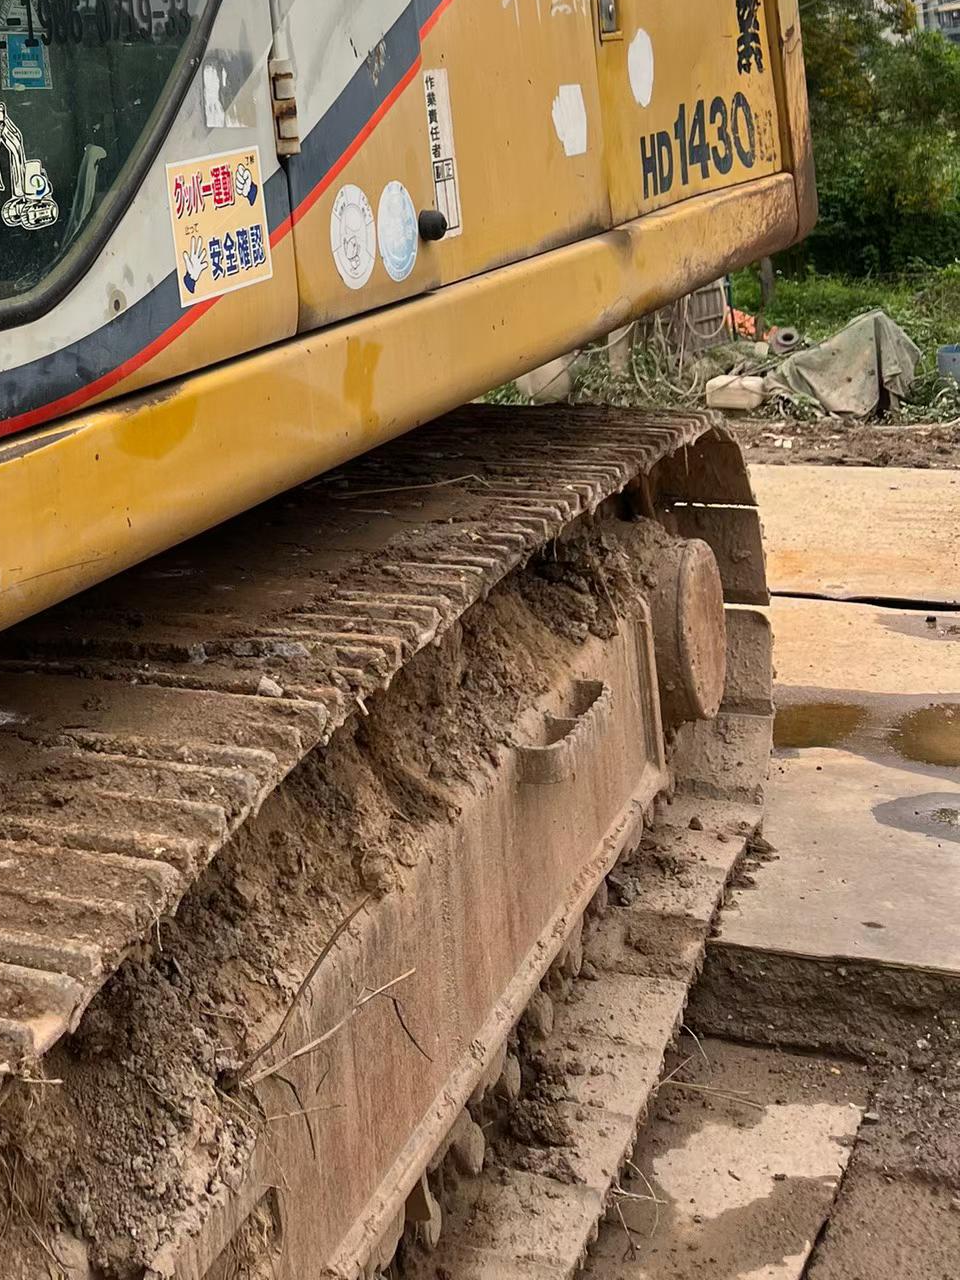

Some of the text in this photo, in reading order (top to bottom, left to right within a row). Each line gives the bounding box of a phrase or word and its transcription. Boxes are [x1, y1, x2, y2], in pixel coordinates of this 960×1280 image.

[425, 75, 441, 159] 作業責任者
[640, 91, 756, 200] HD1430
[208, 224, 266, 280] 安全確認
